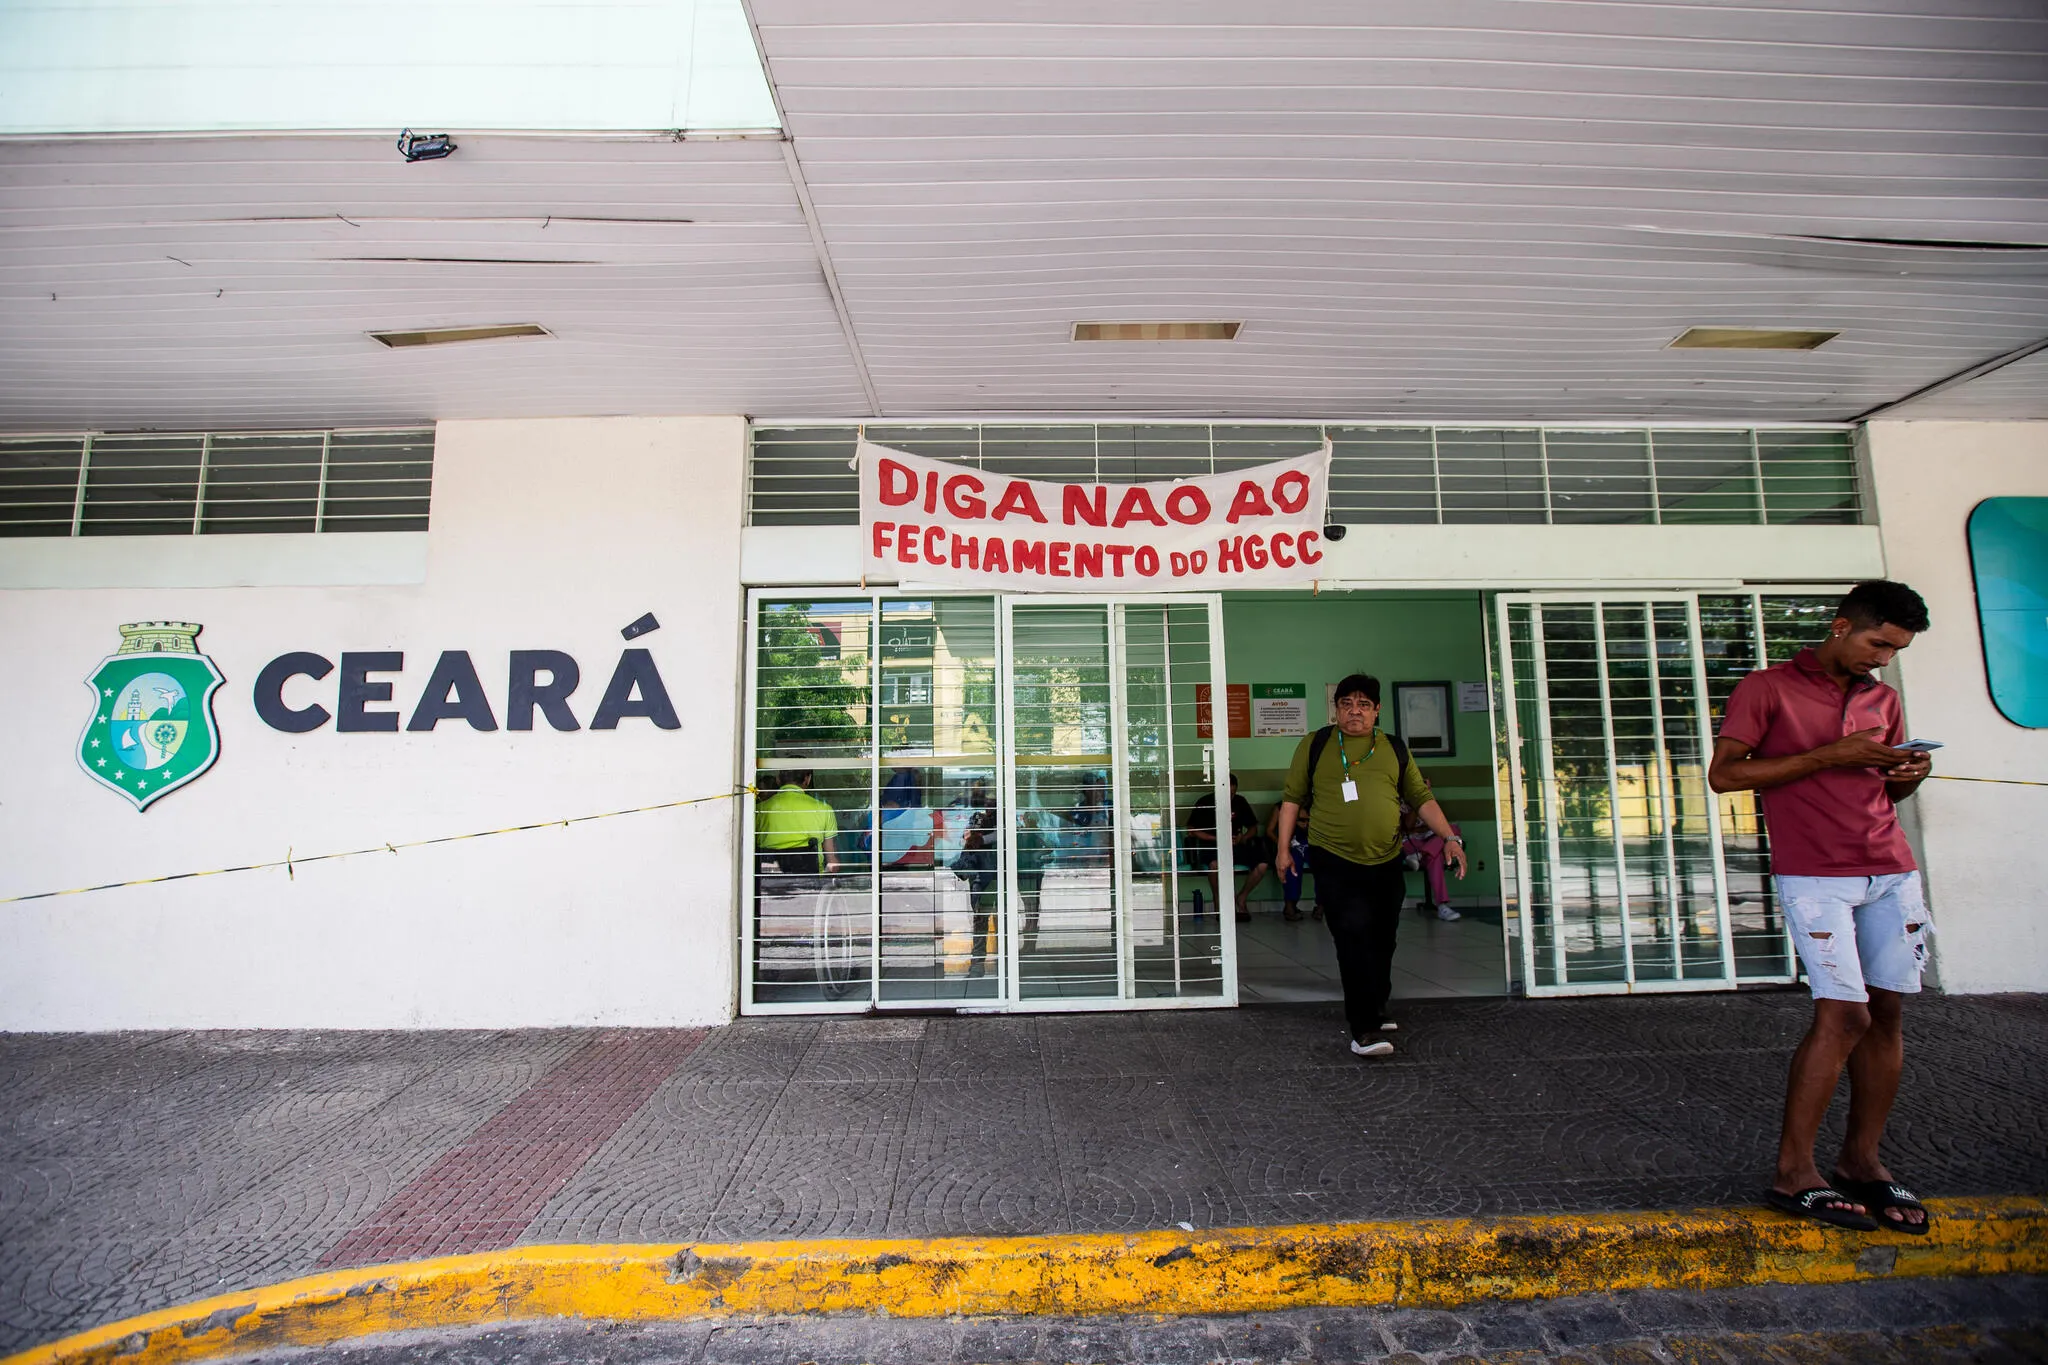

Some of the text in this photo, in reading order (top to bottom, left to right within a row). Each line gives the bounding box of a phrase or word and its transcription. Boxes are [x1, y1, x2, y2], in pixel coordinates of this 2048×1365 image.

[878, 459, 1310, 528] DIGA NAO AO
[873, 522, 1322, 578] FECHAMENTO DO HGCC
[254, 613, 681, 733] CEARÁ
